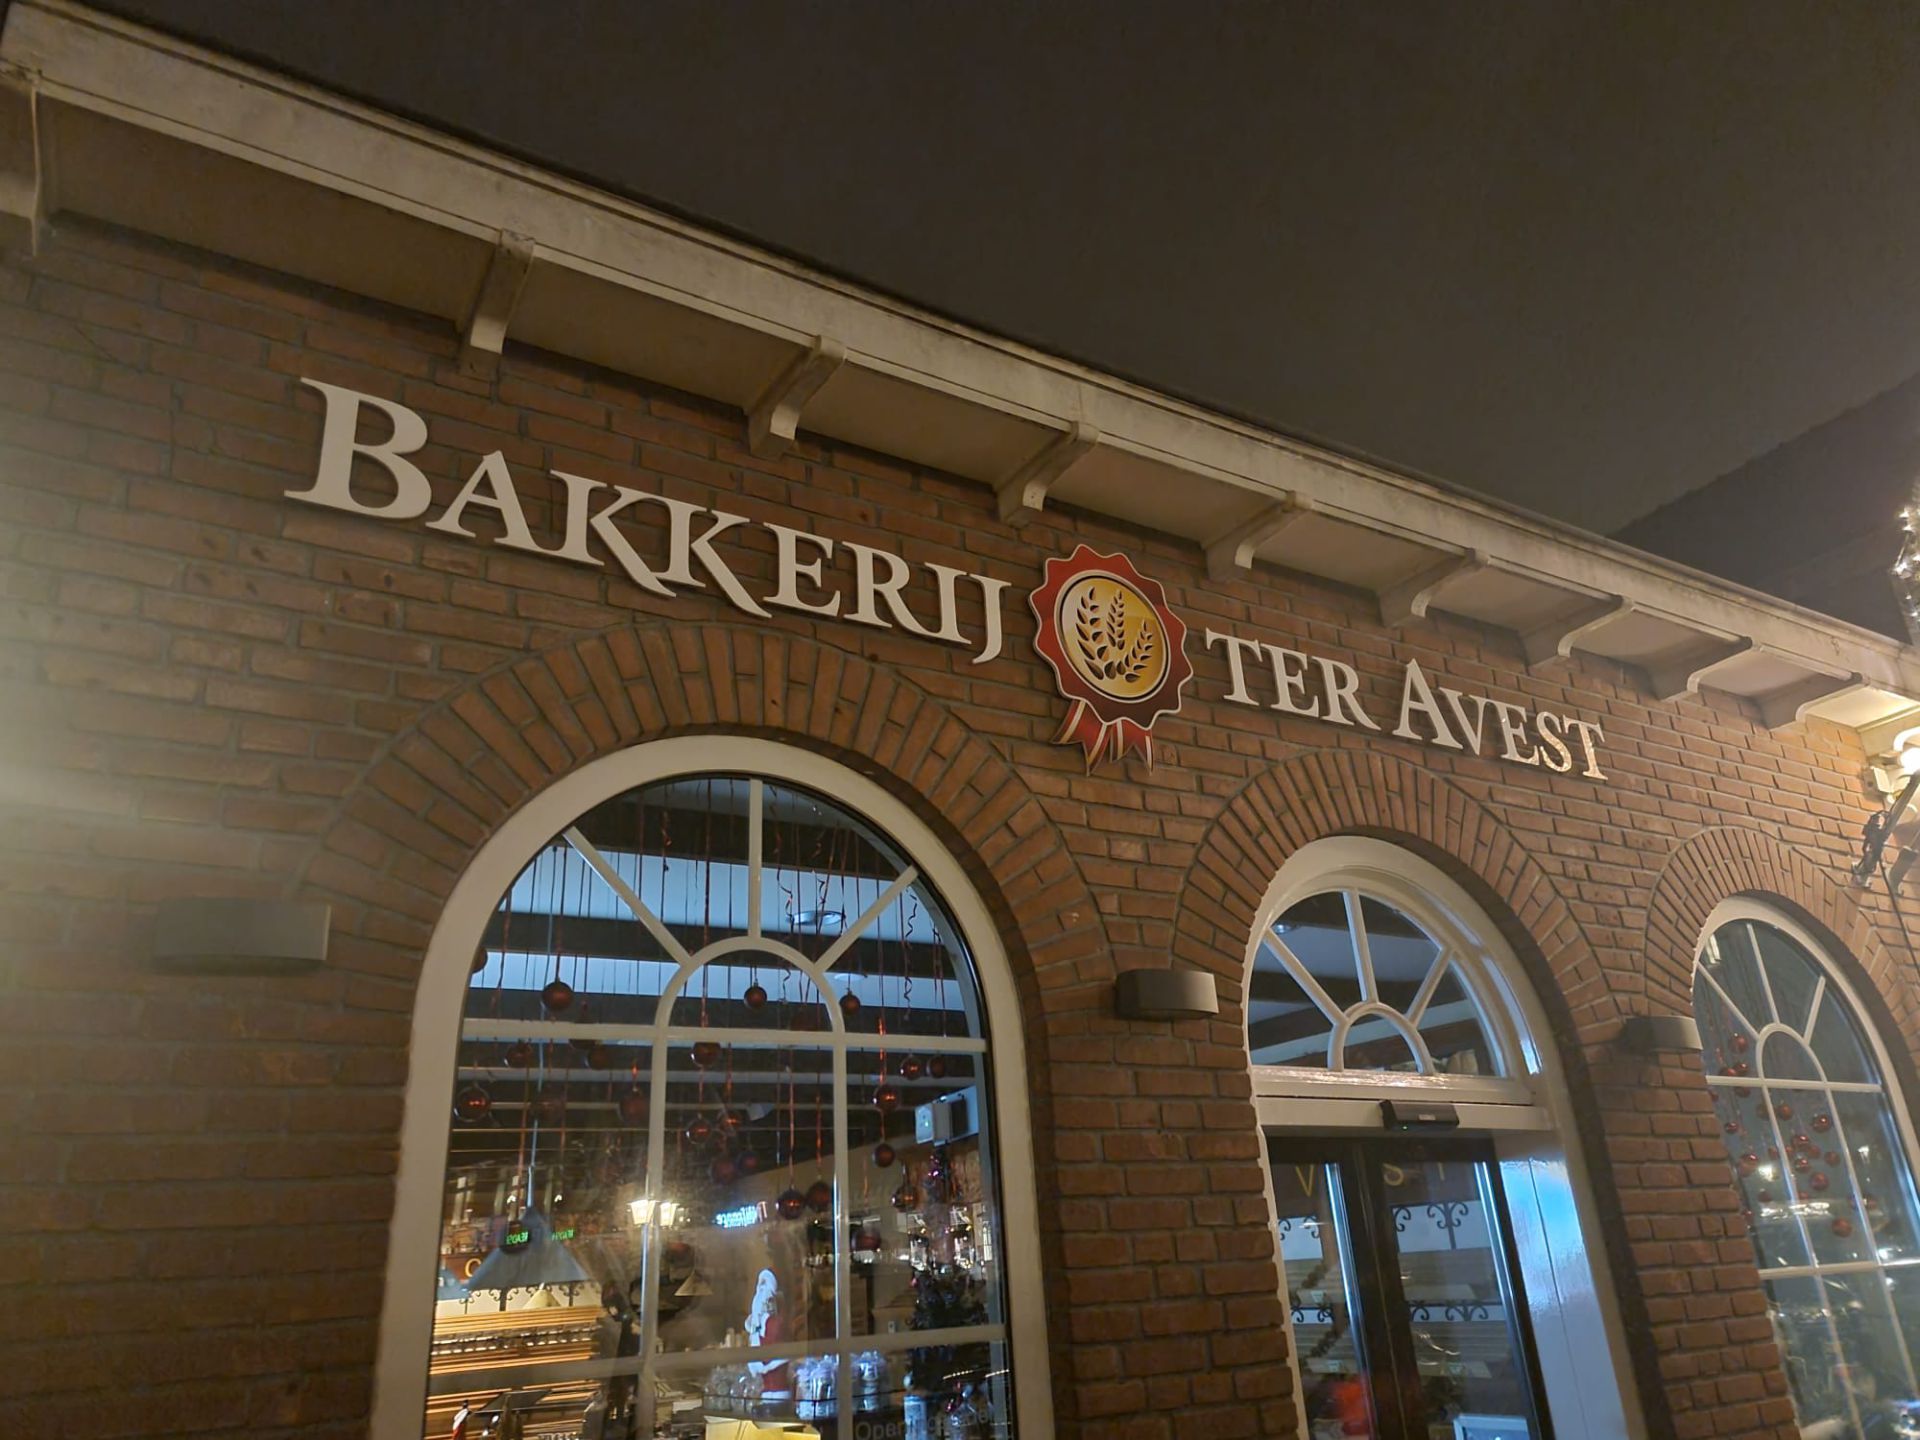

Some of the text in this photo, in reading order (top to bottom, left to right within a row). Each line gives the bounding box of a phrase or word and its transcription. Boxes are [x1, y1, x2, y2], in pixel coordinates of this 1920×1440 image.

[284, 377, 1609, 781] BAKKERIJ TER AVEST
